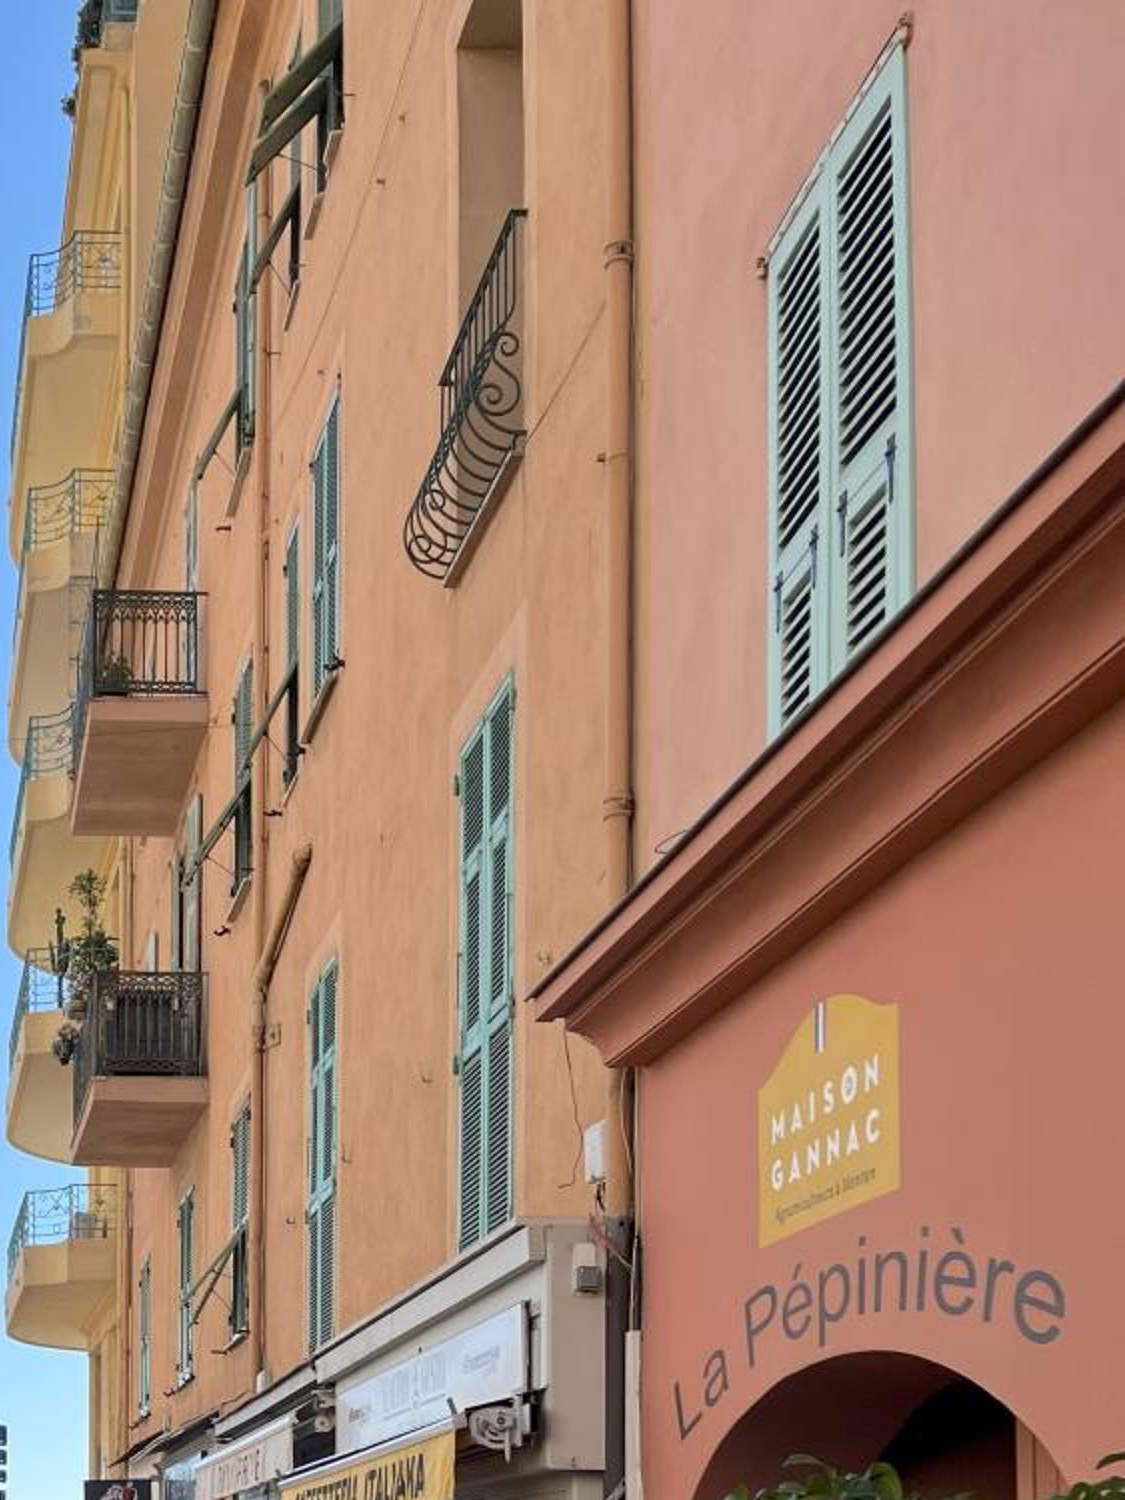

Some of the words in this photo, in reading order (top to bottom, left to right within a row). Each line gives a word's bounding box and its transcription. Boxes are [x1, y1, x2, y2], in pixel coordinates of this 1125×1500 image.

[771, 1053, 880, 1144] MAISON
[771, 1108, 881, 1191] GANNAC
[673, 1349, 731, 1441] La
[743, 1226, 1067, 1368] Pépinière
